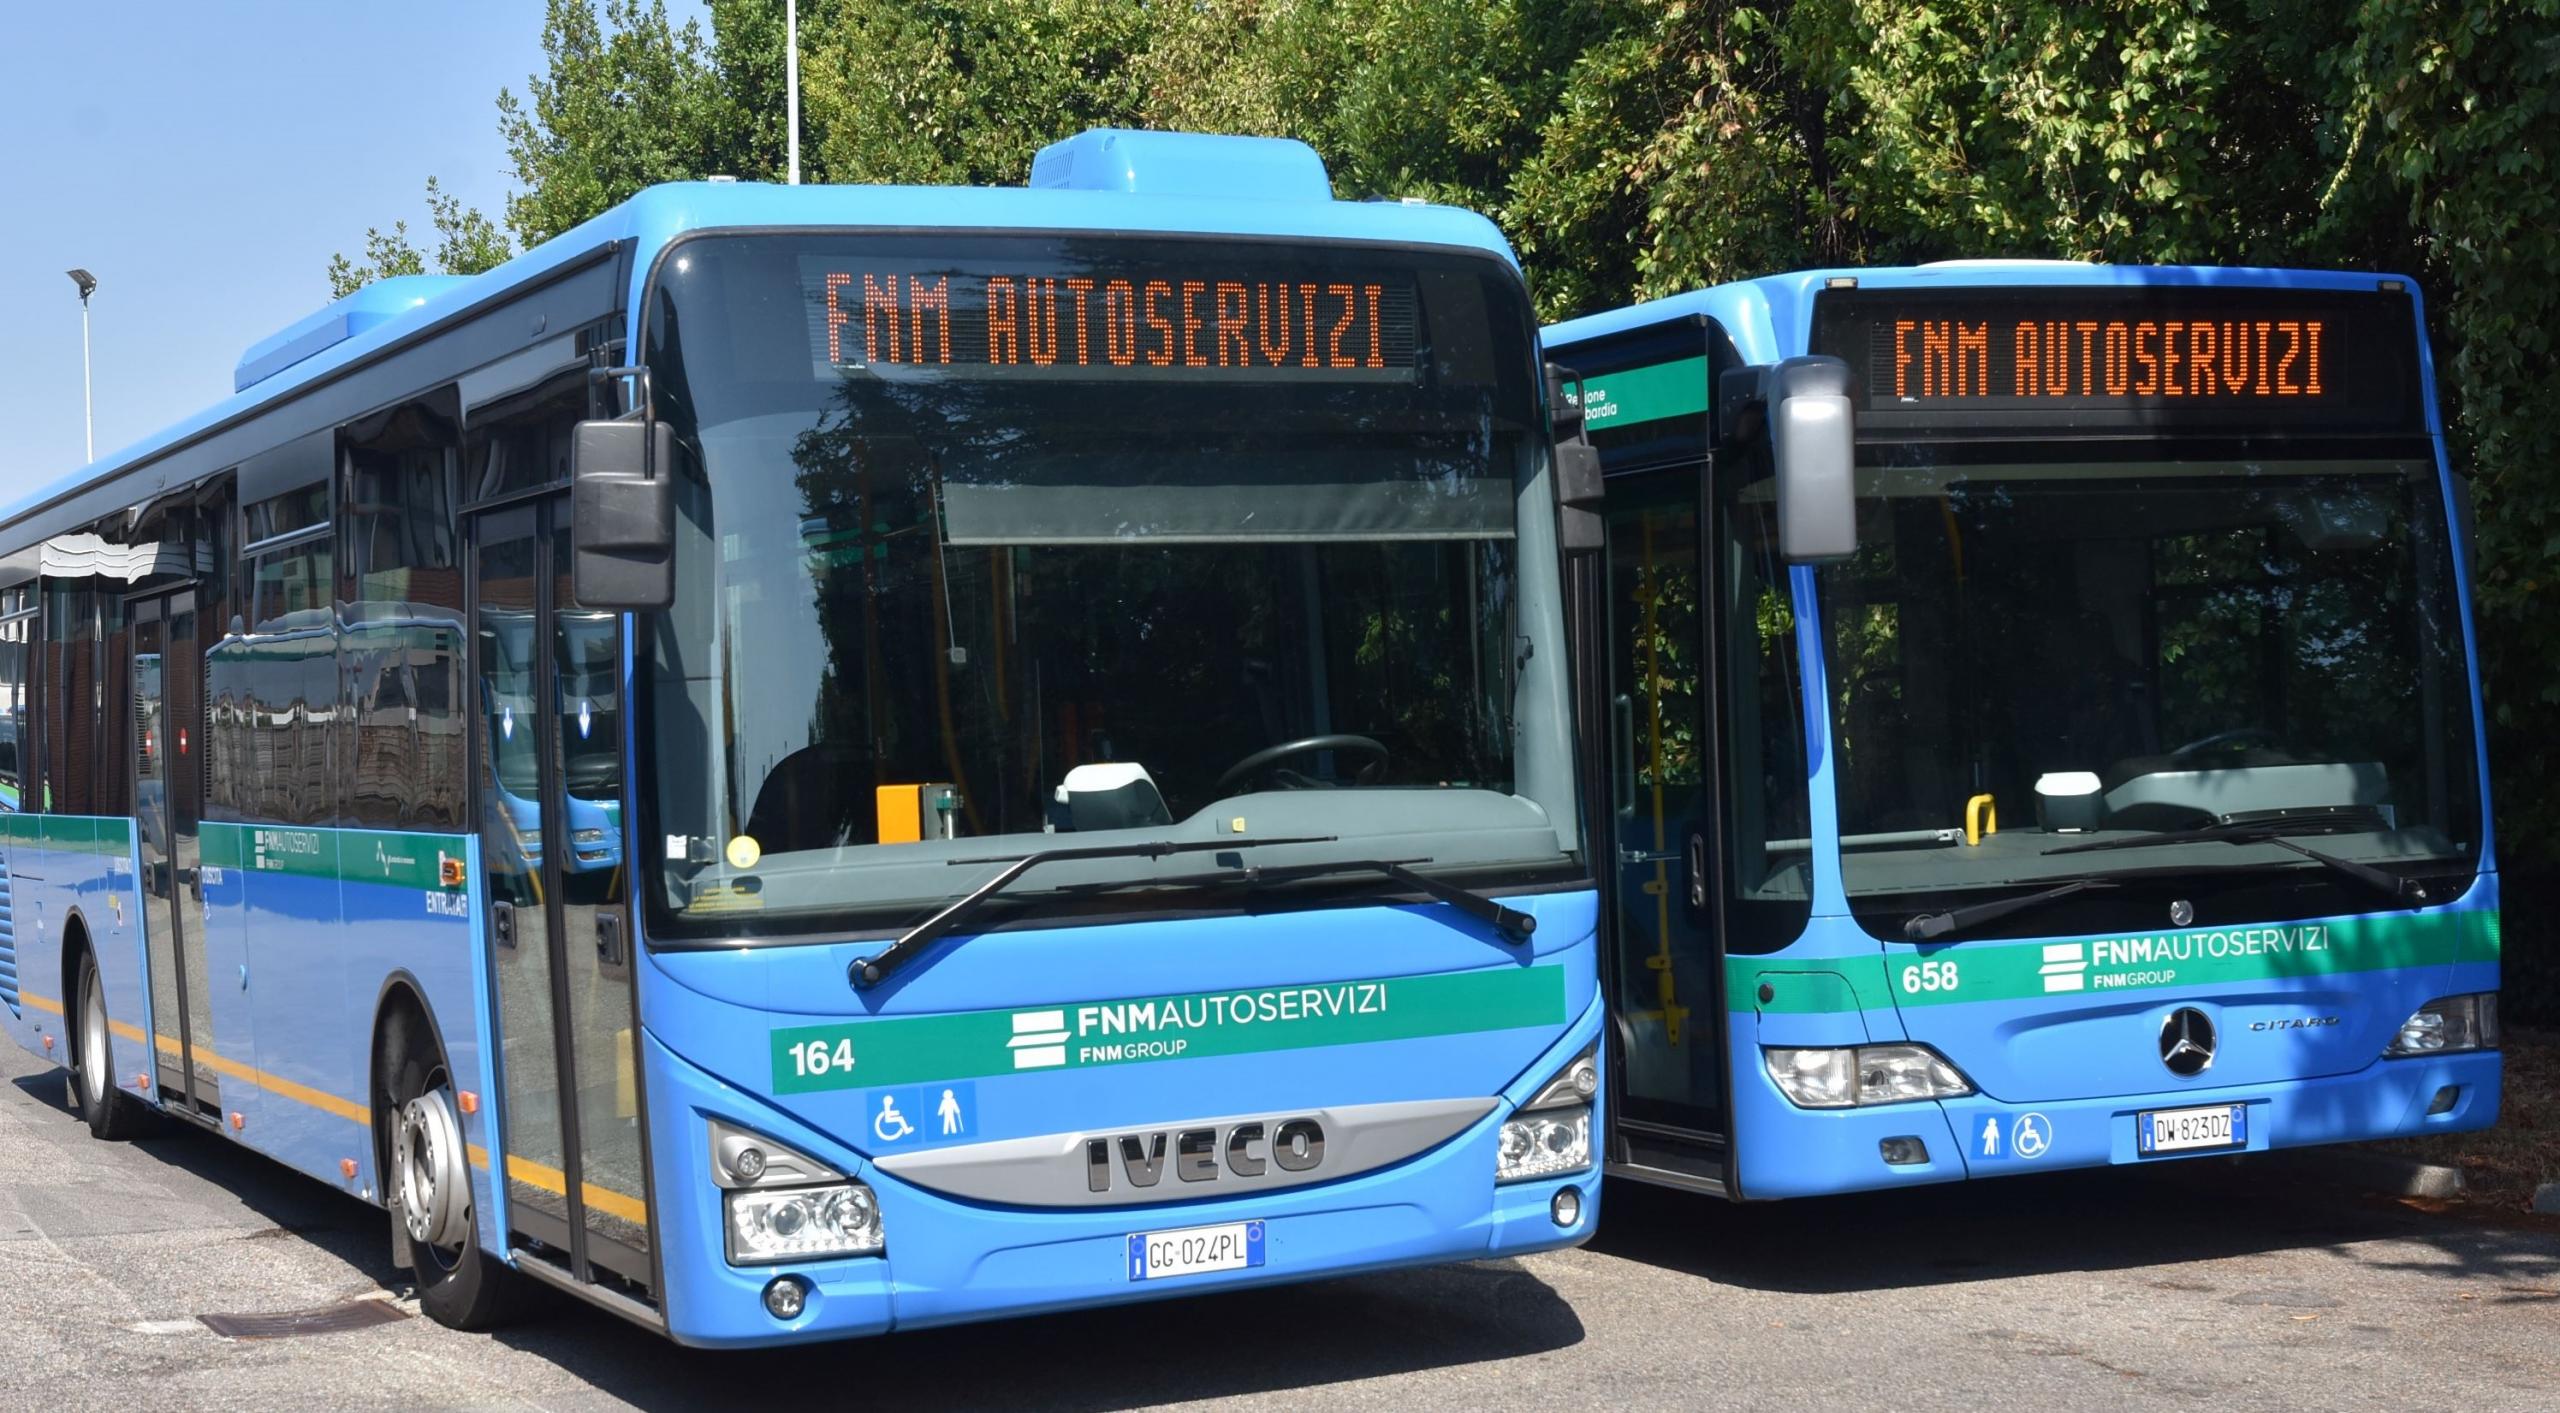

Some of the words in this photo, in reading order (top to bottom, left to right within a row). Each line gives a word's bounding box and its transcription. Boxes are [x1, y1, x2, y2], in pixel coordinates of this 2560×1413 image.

[826, 273, 950, 365] FNM
[987, 276, 1384, 368] AUTOSERVIZI
[1896, 321, 1988, 397] FNM
[2015, 321, 2322, 396] AUTOSERVIZI
[2092, 926, 2329, 966] FNMAUTOSERVIZI
[1902, 962, 1959, 993] 658
[2093, 970, 2176, 988] FNMGROUP
[1078, 983, 1387, 1037] FNMAUTOSERVIZI
[2249, 1016, 2340, 1031] CITARO
[788, 1038, 855, 1076] 164
[1080, 1040, 1187, 1063] FNMGROUP
[1087, 1117, 1326, 1192] IVECO
